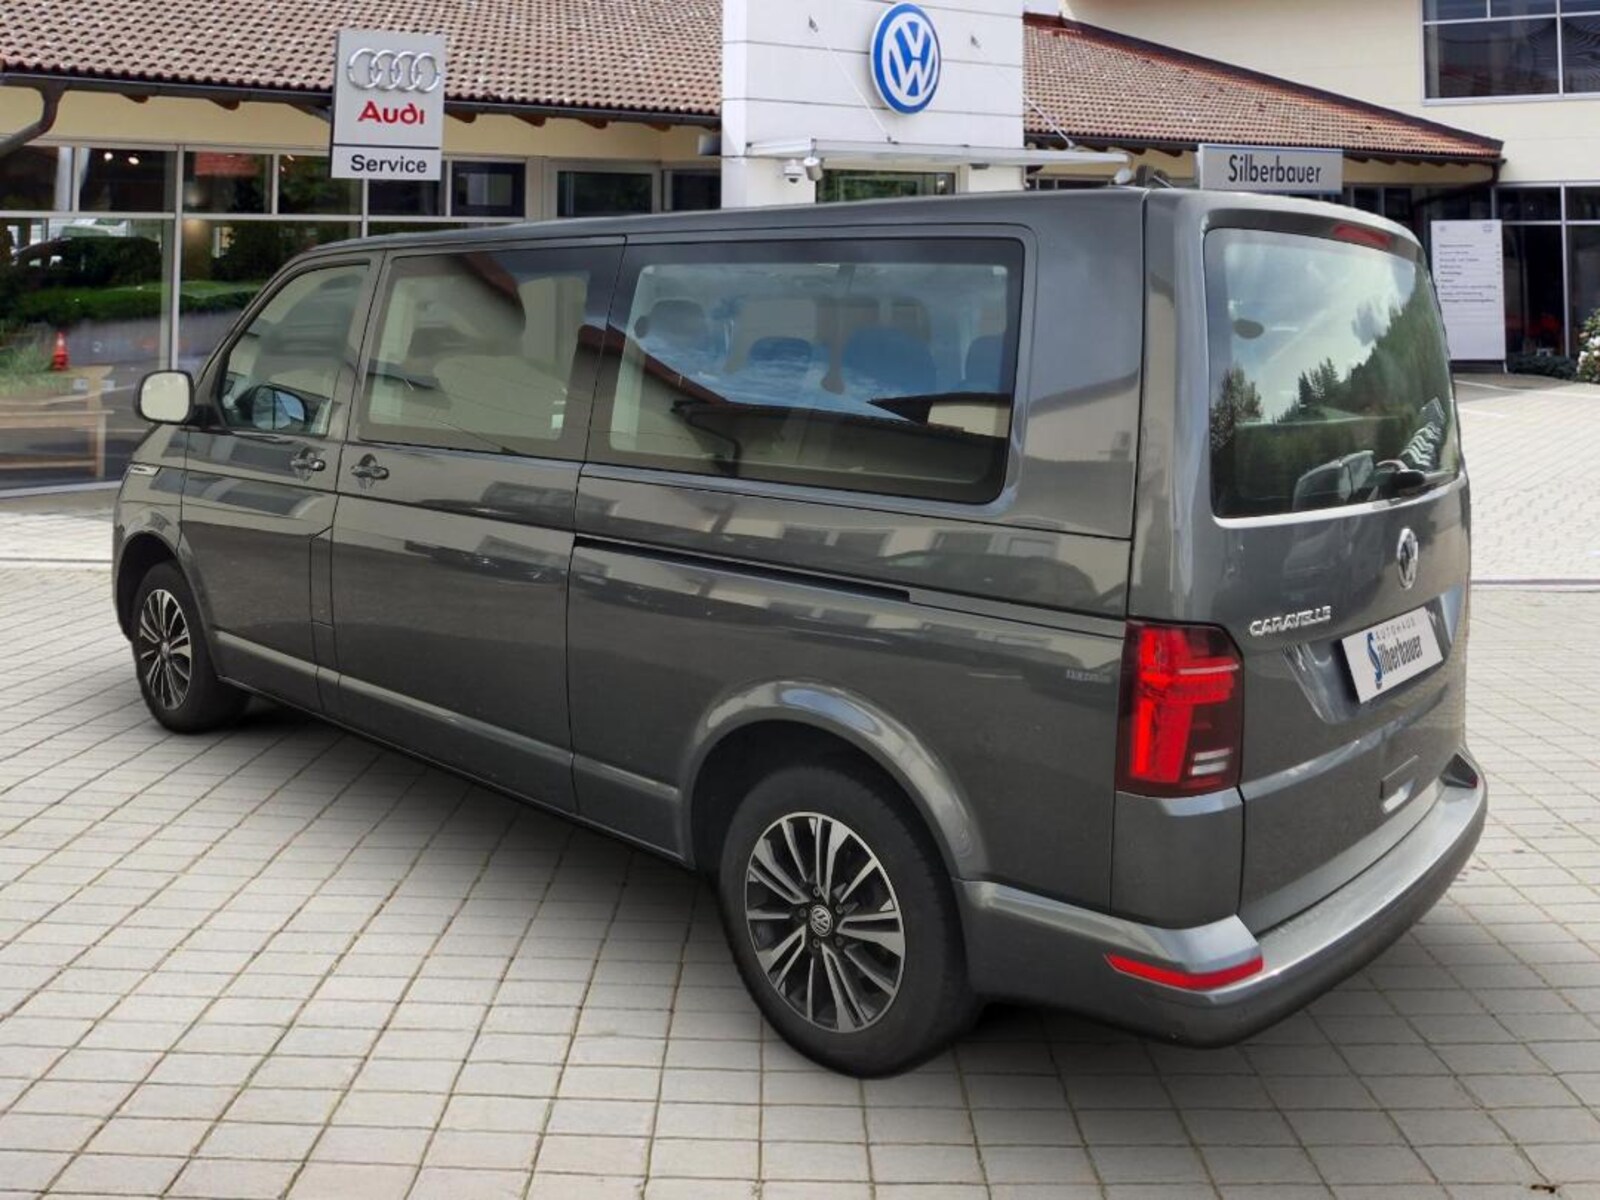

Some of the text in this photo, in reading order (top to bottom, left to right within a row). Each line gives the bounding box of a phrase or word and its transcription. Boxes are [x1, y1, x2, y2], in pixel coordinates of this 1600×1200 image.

[357, 100, 425, 125] Audi
[350, 153, 428, 173] Service
[1228, 153, 1321, 183] Silberbauer
[1249, 605, 1332, 637] CARAVELLE
